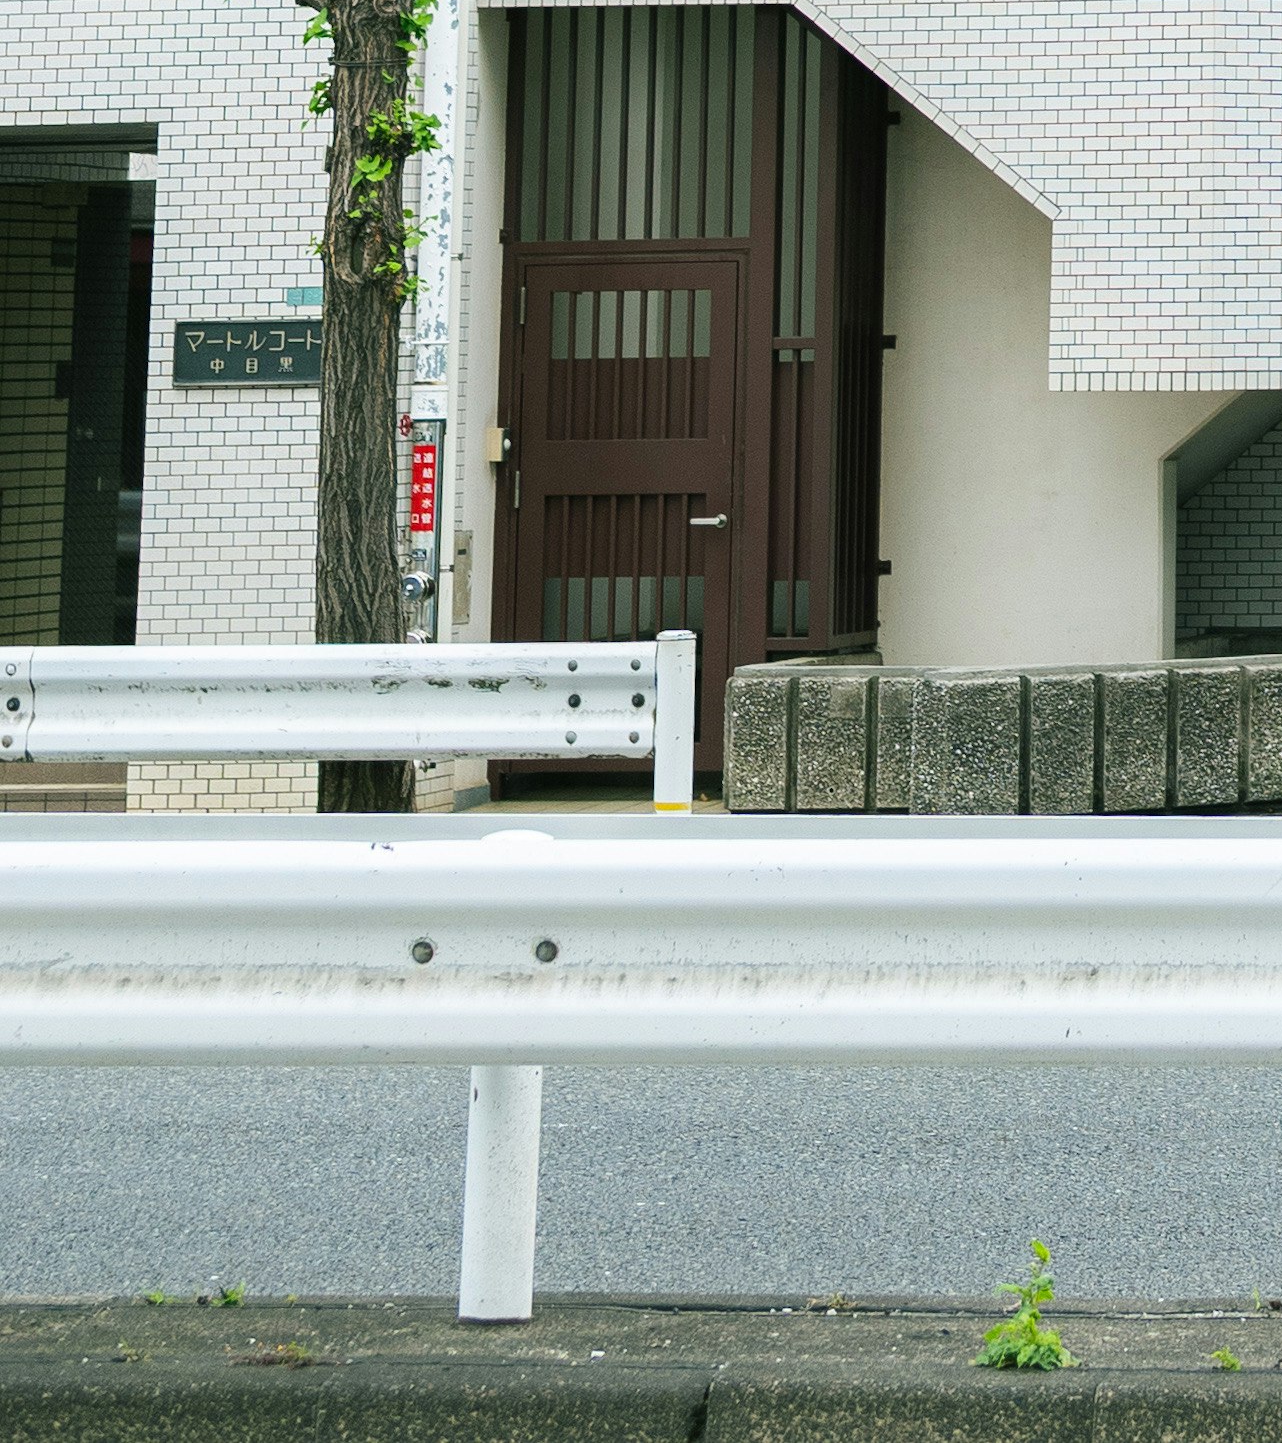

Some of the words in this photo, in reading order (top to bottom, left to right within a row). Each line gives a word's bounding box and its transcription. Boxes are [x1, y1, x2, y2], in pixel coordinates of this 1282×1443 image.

[185, 329, 322, 352] マートルコート
[210, 356, 293, 374] 中目黒
